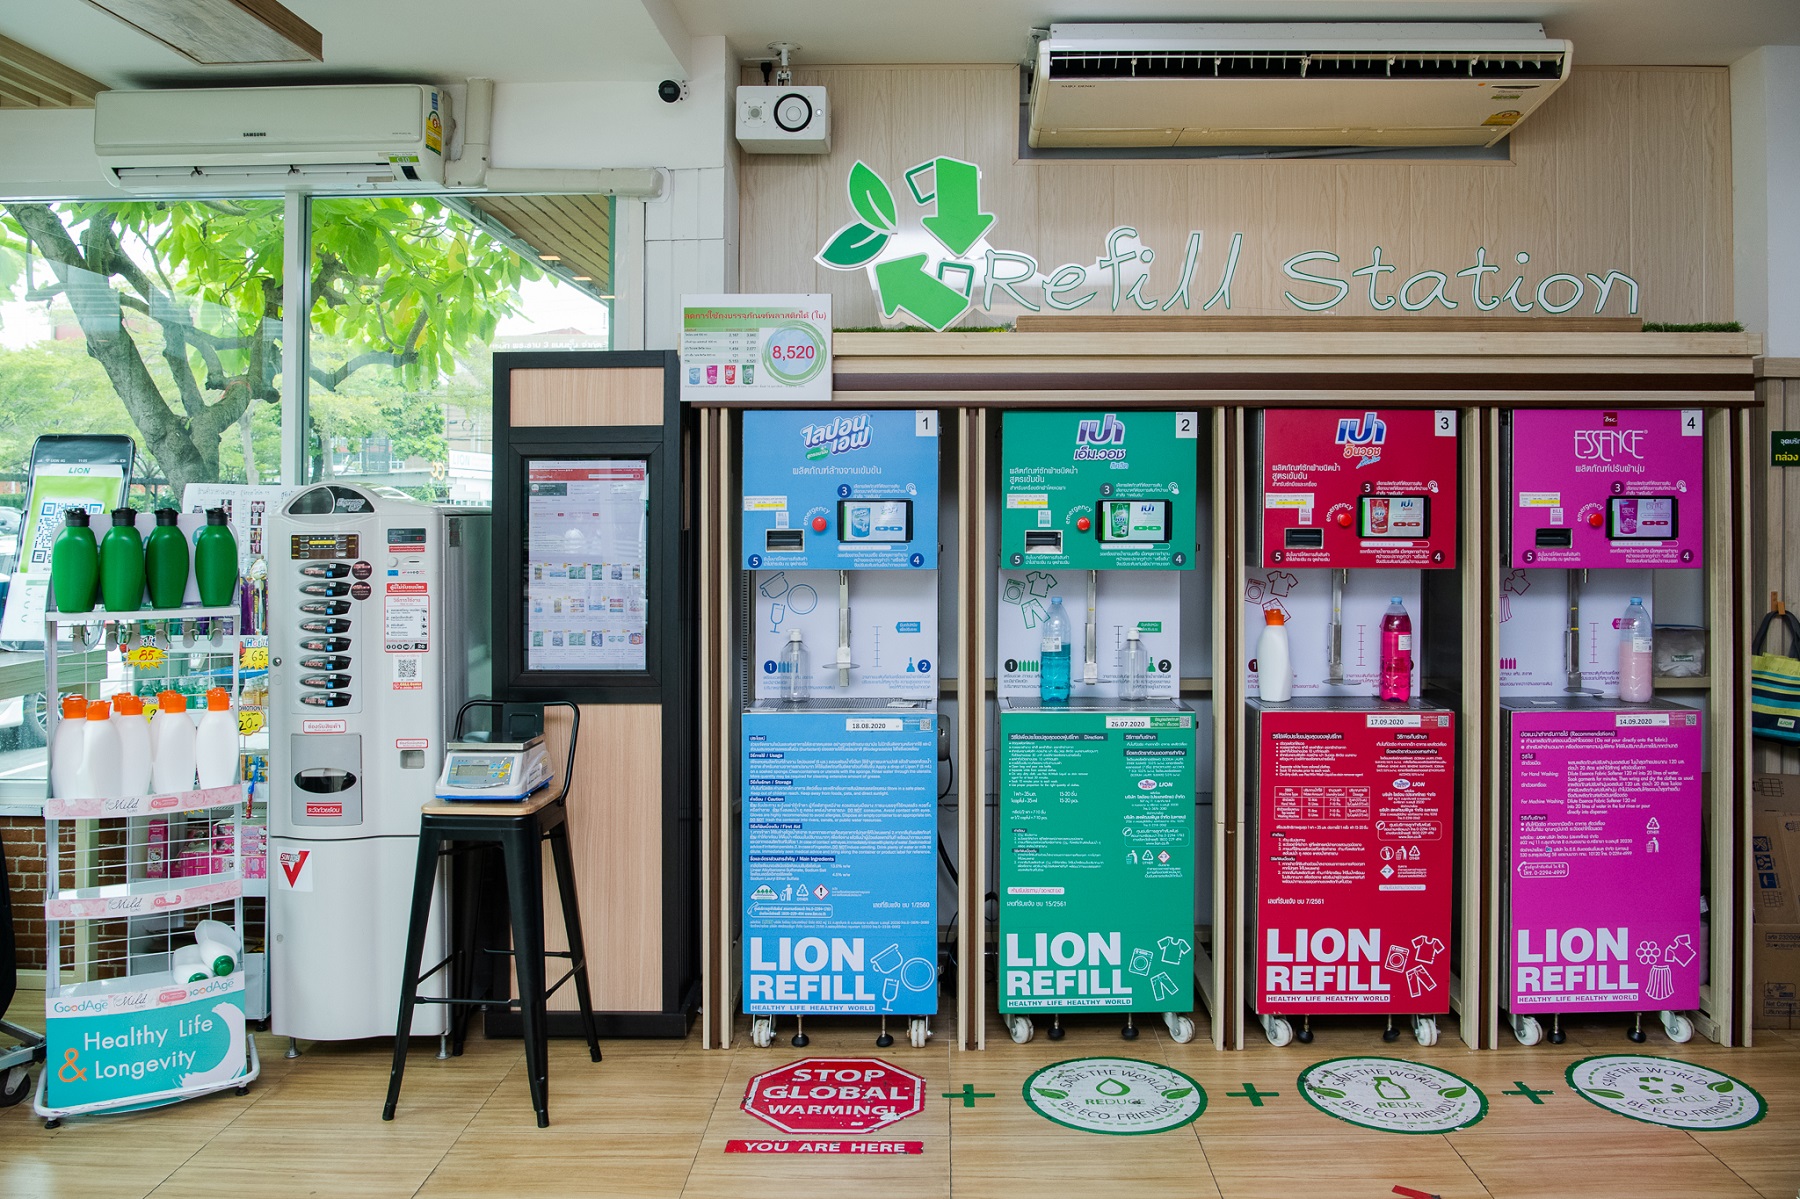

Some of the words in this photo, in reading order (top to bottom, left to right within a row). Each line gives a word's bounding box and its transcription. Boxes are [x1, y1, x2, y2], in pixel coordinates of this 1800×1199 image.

[983, 225, 1244, 312] Refill
[1283, 246, 1640, 314] Station
[772, 346, 815, 361] 8,520
[922, 417, 929, 430] 1
[1076, 414, 1126, 444] เปา
[1181, 418, 1190, 432] 2
[1336, 412, 1387, 444] เปา
[1440, 417, 1450, 430] 3
[1687, 416, 1696, 429] 4
[802, 414, 870, 447] ไลปอน
[831, 430, 872, 454] เอฟ
[1574, 430, 1644, 462] ESSENCE
[1074, 445, 1127, 460] เอ็ม.วอช
[1343, 444, 1382, 458] วินวอช
[1776, 452, 1798, 461] กล่อง
[792, 465, 882, 476] ผลิตภัณฑ์ล้างจานเข้มข้น
[1010, 466, 1078, 475] ผลิตภัณฑ์ซักผ้าชนิดน้ำ
[1272, 462, 1340, 472] ผลิตภัณฑ์ซักผ้าชนิดน้ำ
[1576, 464, 1645, 474] ผลิตภัณฑ์ปรับผ้านุ่ม
[1010, 475, 1045, 484] สูตรเข้มข้น
[1272, 472, 1308, 482] สูตรเข้มข้น
[842, 486, 848, 496] 3
[1104, 486, 1110, 494] 3
[1364, 484, 1370, 492] 3
[1614, 484, 1620, 492] 3
[803, 506, 830, 526] emergency
[1066, 505, 1093, 524] emergency
[1326, 502, 1353, 522] emergency
[1577, 502, 1604, 522] emergency
[752, 556, 758, 566] 5
[914, 556, 920, 564] 4
[1014, 555, 1020, 564] 5
[1176, 554, 1182, 563] 4
[1275, 552, 1282, 561] 5
[1434, 552, 1441, 561] 4
[1526, 552, 1532, 561] 5
[1684, 552, 1690, 560] 4
[138, 650, 154, 660] 85
[922, 662, 927, 670] 2
[1162, 661, 1168, 670] 2
[110, 798, 140, 809] Mild
[113, 898, 143, 909] Mild
[1006, 932, 1122, 967] LION
[1266, 928, 1380, 963] LION
[1518, 928, 1628, 963] LION
[750, 937, 865, 972] LION
[1006, 970, 1132, 996] REFILL
[1266, 966, 1390, 992] REFILL
[1518, 964, 1638, 992] REFILL
[750, 974, 876, 1000] REFILL
[54, 1000, 108, 1013] GoodAge
[118, 994, 148, 1007] Mild
[84, 1024, 168, 1051] Healthy
[178, 1014, 213, 1038] Life
[58, 1048, 87, 1082] &
[96, 1050, 196, 1080] Longevity
[792, 1069, 886, 1082] STOP
[1059, 1072, 1088, 1089] SAVE
[1121, 1070, 1168, 1091] WORLD
[1332, 1070, 1360, 1088] SAVE
[1389, 1069, 1442, 1090] WORLD
[1602, 1070, 1620, 1088] SAVE
[1616, 1066, 1645, 1078] THE
[1646, 1066, 1708, 1086] WORLD
[762, 1086, 908, 1100] GLOBAL
[1648, 1094, 1712, 1105] RECYCLE
[768, 1105, 896, 1116] WARMING!
[1060, 1100, 1078, 1112] BE
[1342, 1100, 1362, 1110] BE
[1626, 1100, 1648, 1110] BE
[744, 1142, 790, 1152] YOU
[798, 1143, 841, 1152] ARE
[850, 1144, 906, 1152] HERE
